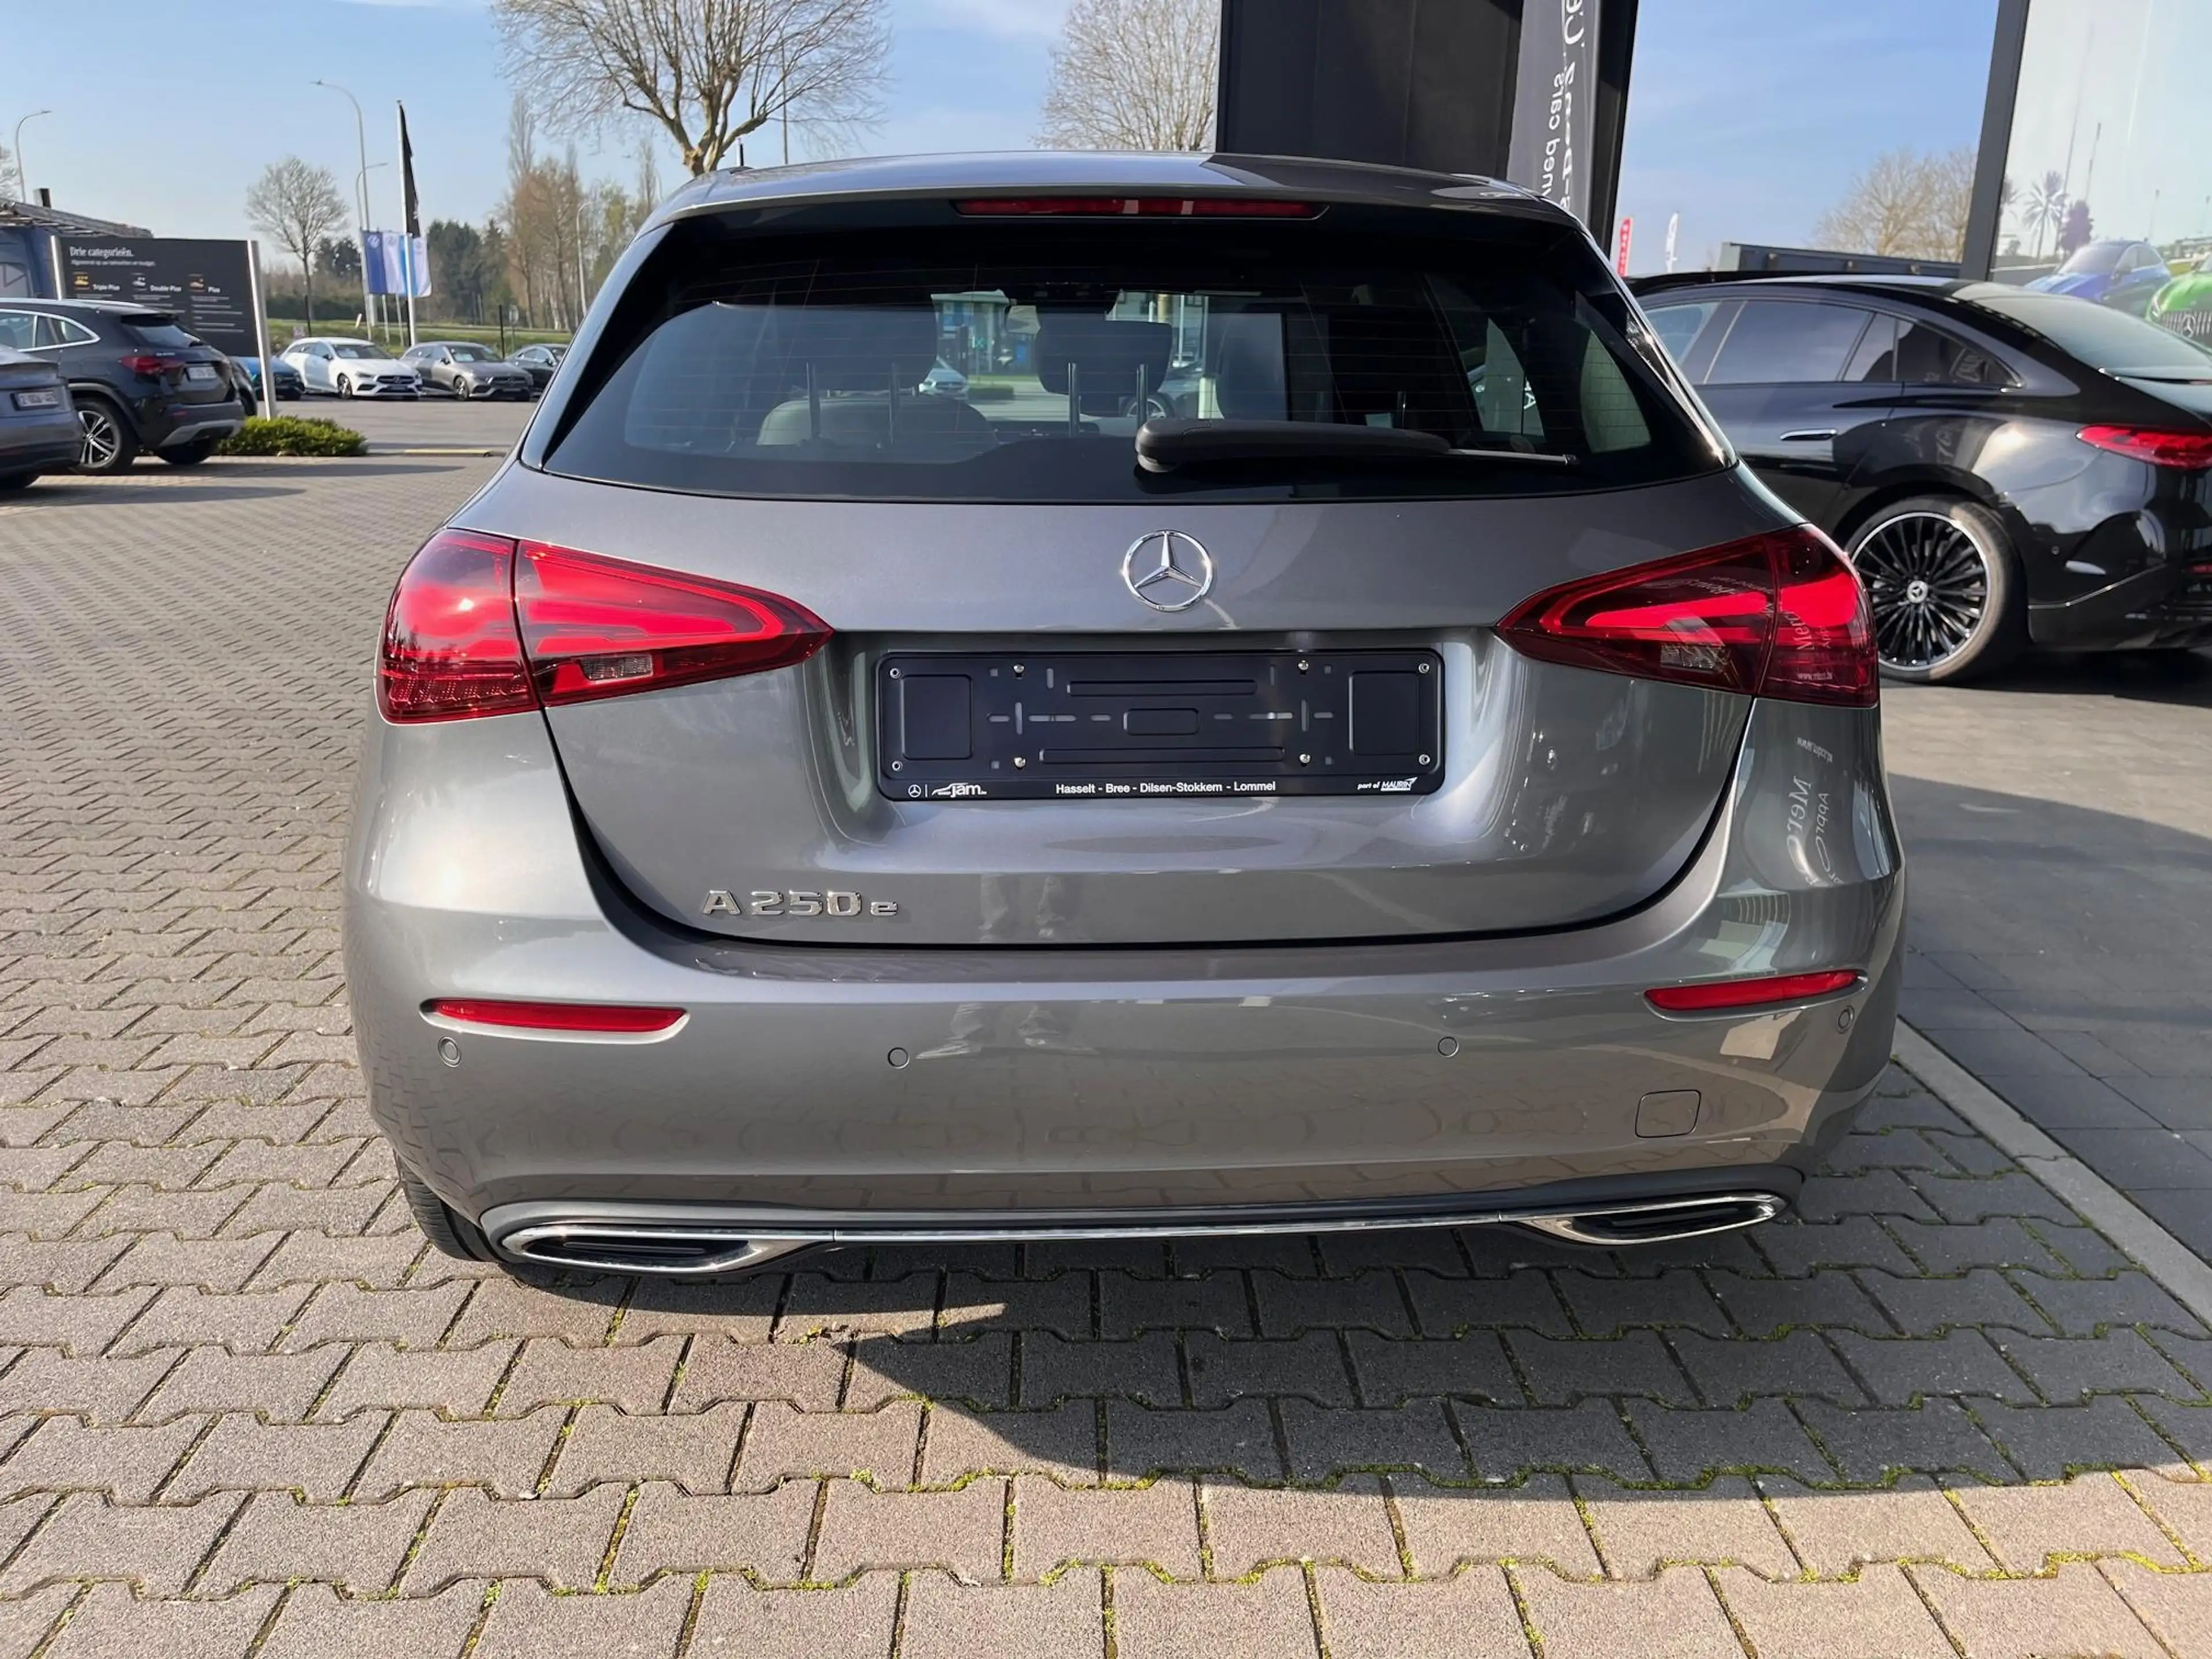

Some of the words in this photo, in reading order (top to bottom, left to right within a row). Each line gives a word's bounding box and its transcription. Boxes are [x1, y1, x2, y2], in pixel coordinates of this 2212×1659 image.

[1055, 783, 1095, 794] Hasselt
[1105, 783, 1131, 793] Bree
[1139, 782, 1222, 793] Dilsen-Stokkem
[1234, 781, 1275, 791] Lommel
[1357, 783, 1372, 791] part
